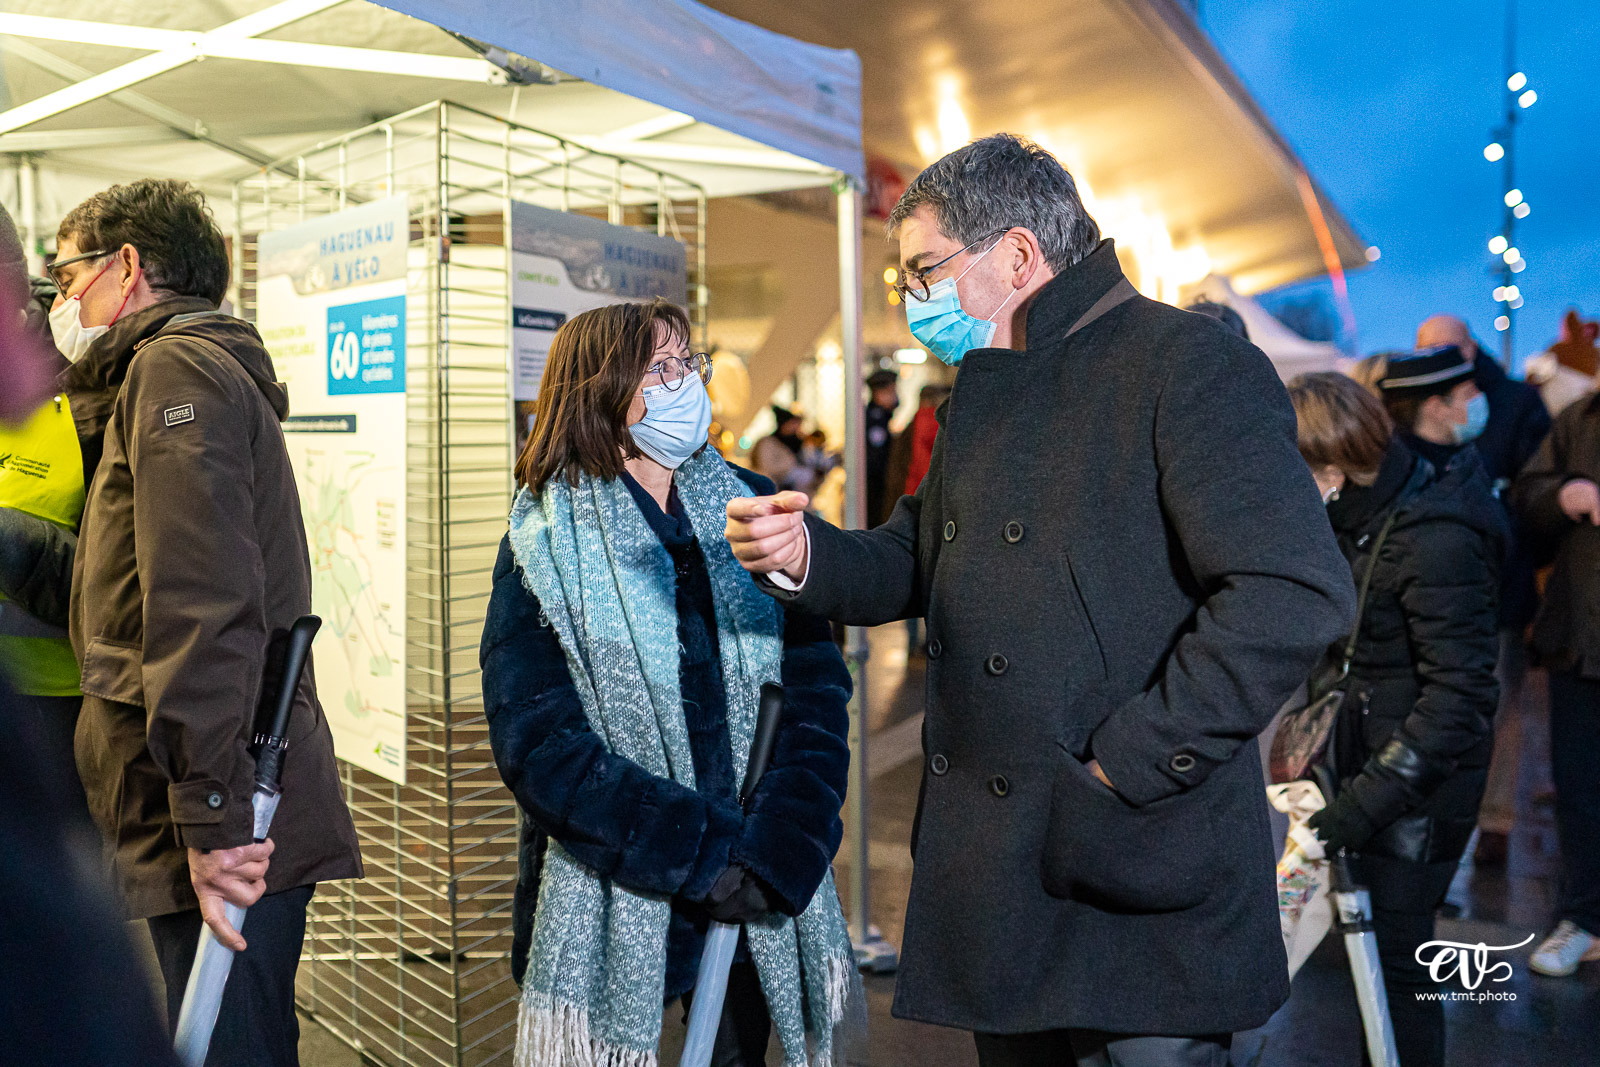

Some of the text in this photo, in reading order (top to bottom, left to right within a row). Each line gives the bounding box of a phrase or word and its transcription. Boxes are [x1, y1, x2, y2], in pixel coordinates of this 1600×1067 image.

[319, 221, 394, 257] HAGUENAU
[604, 243, 678, 274] HAGUENAU
[330, 331, 360, 380] 60
[168, 408, 190, 419] AIGLE
[15, 455, 51, 468] Communauté
[16, 467, 47, 479] Haguenau
